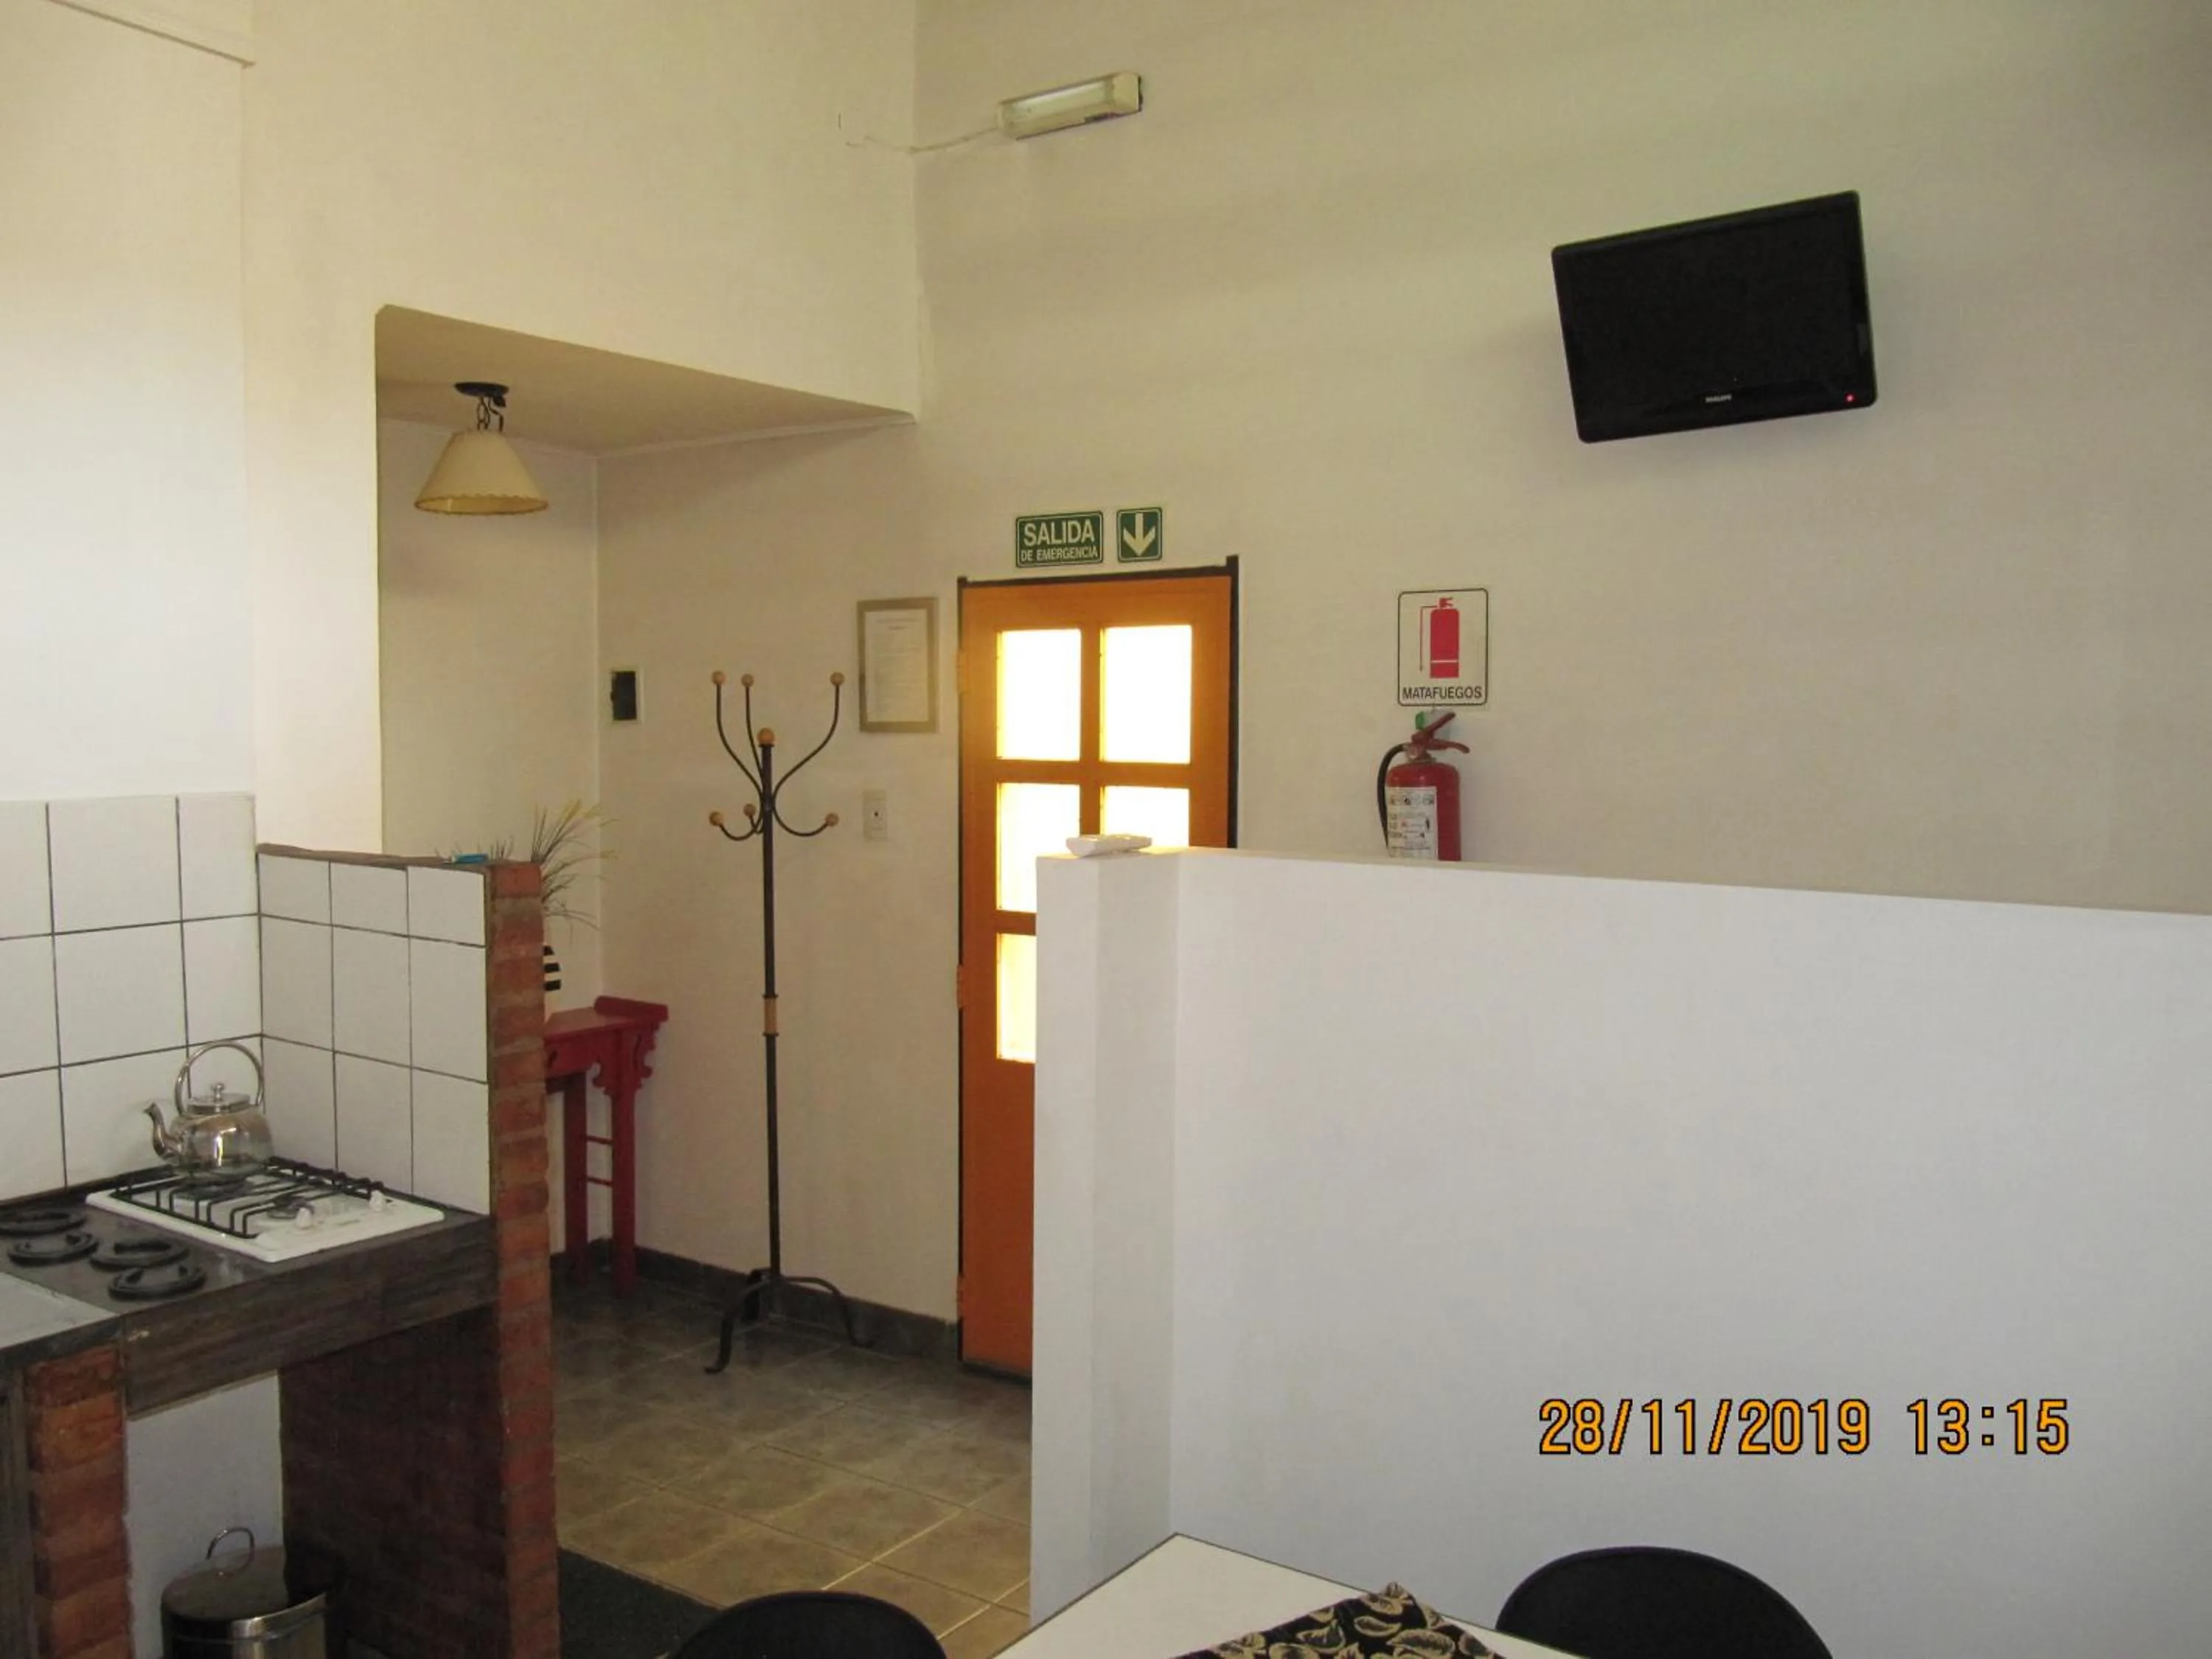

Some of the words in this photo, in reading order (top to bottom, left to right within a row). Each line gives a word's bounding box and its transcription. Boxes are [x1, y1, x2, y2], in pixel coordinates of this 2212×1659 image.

[1023, 519, 1095, 546] SALIDA
[1020, 549, 1033, 562] DE
[1036, 545, 1098, 561] EMERGENCIA
[1402, 686, 1482, 700] MATAFUEGOS
